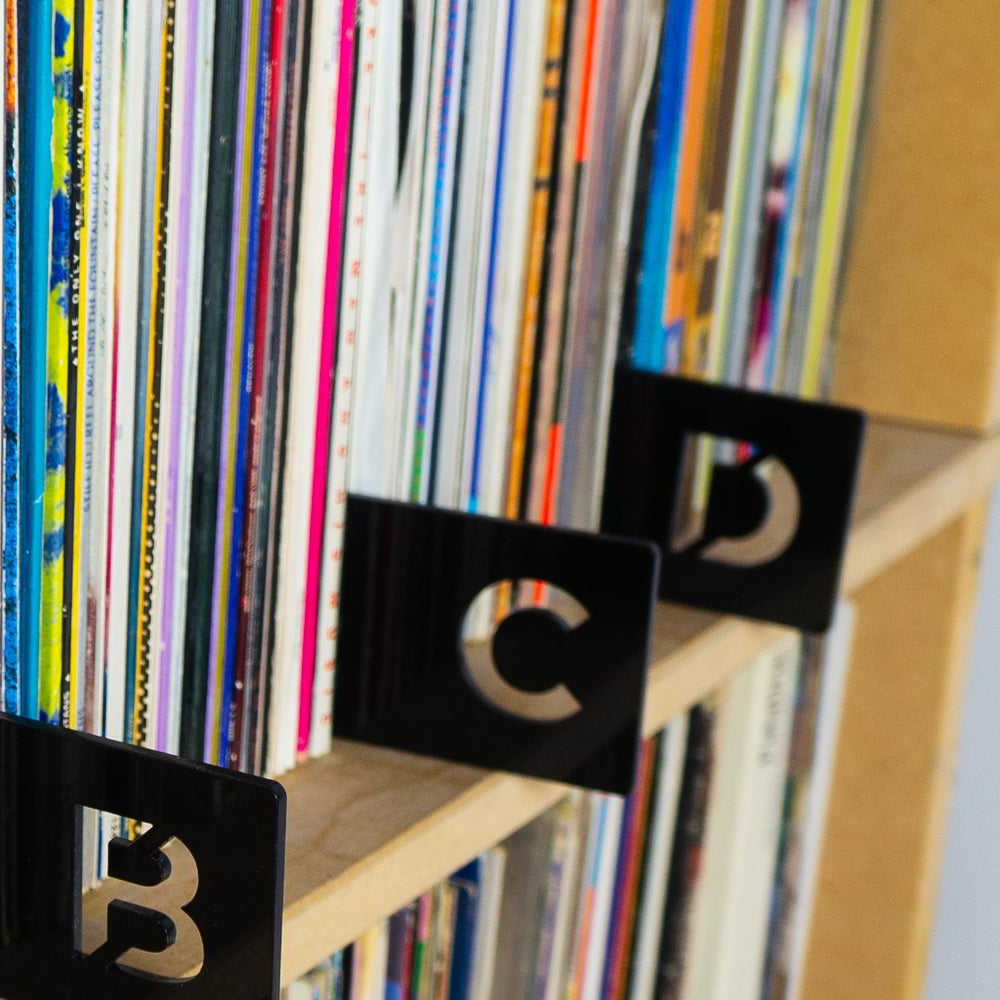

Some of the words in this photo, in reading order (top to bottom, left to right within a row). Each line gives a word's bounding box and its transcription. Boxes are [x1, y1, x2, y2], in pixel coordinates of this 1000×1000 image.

[71, 317, 79, 354] THE
[669, 432, 800, 567] D
[458, 577, 591, 723] C
[73, 803, 204, 984] B
